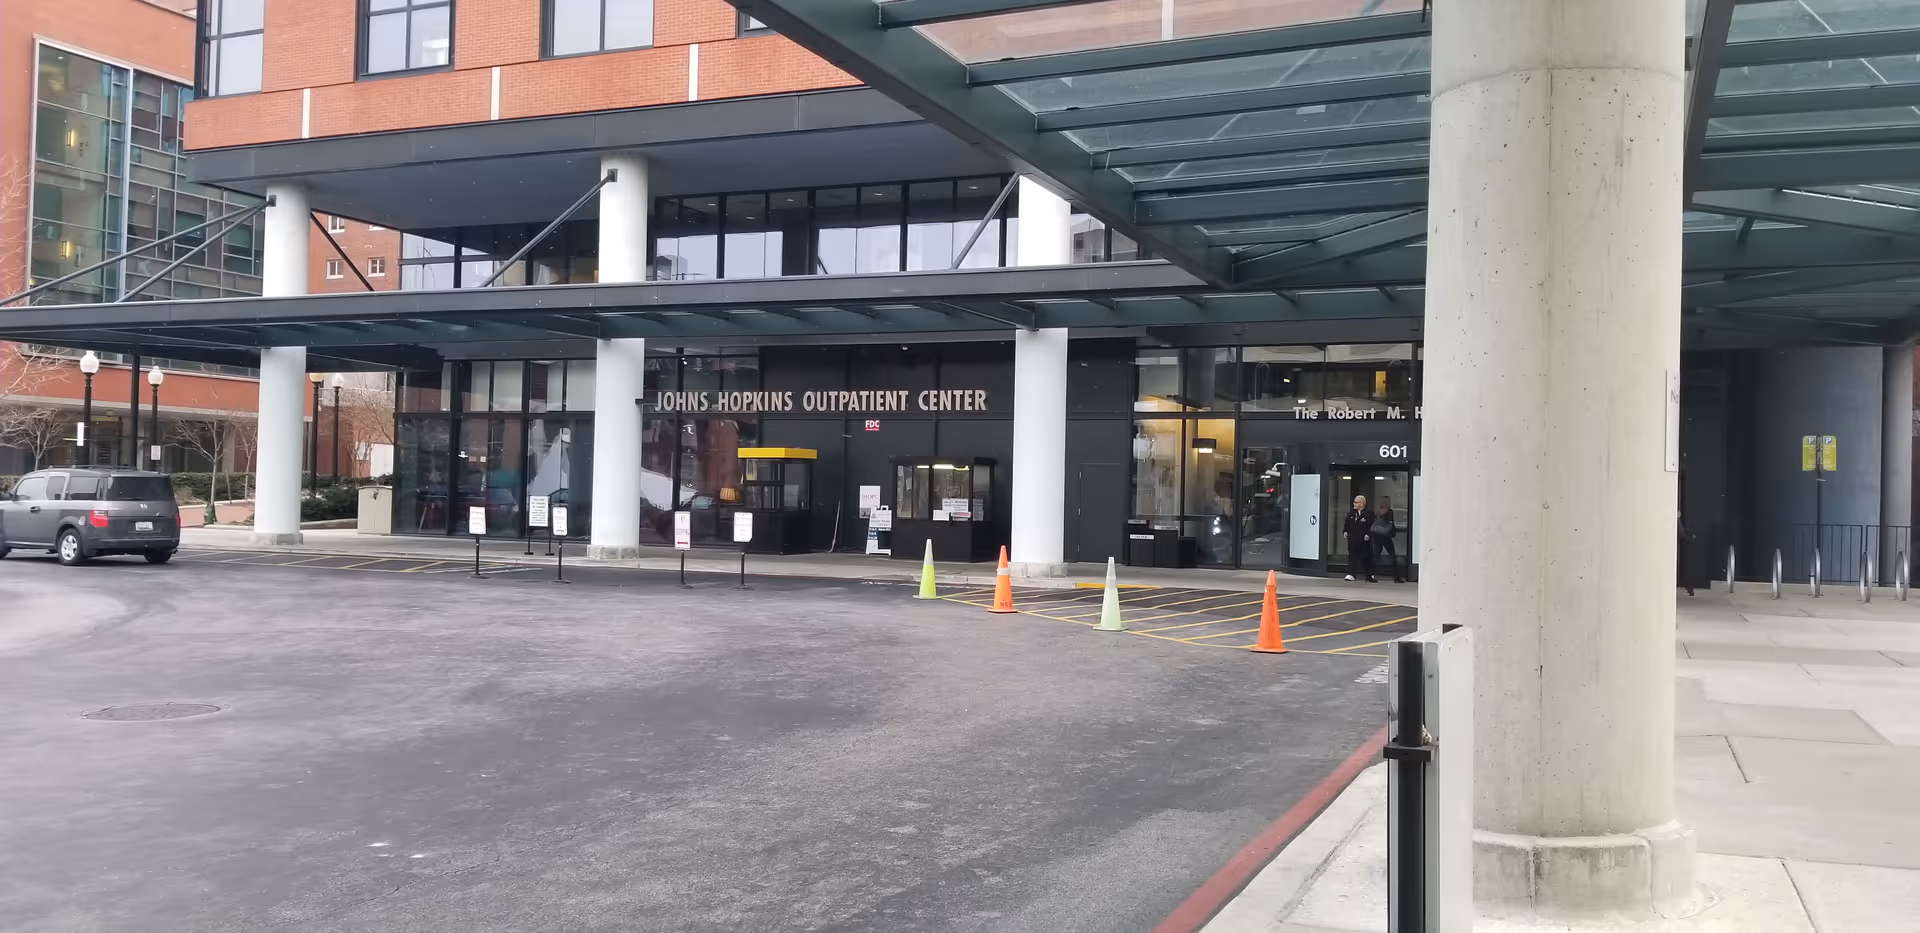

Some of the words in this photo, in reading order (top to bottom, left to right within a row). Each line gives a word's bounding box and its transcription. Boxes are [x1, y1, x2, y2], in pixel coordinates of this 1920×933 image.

[655, 391, 709, 412] JOHNS
[718, 391, 793, 411] HOPKINS
[802, 390, 909, 412] OUTPATIENT
[918, 389, 987, 411] CENTER
[1293, 406, 1319, 420] The
[1328, 406, 1376, 420] Robert
[1386, 406, 1406, 420] M.
[865, 420, 880, 428] FDC
[1379, 445, 1407, 458] 601
